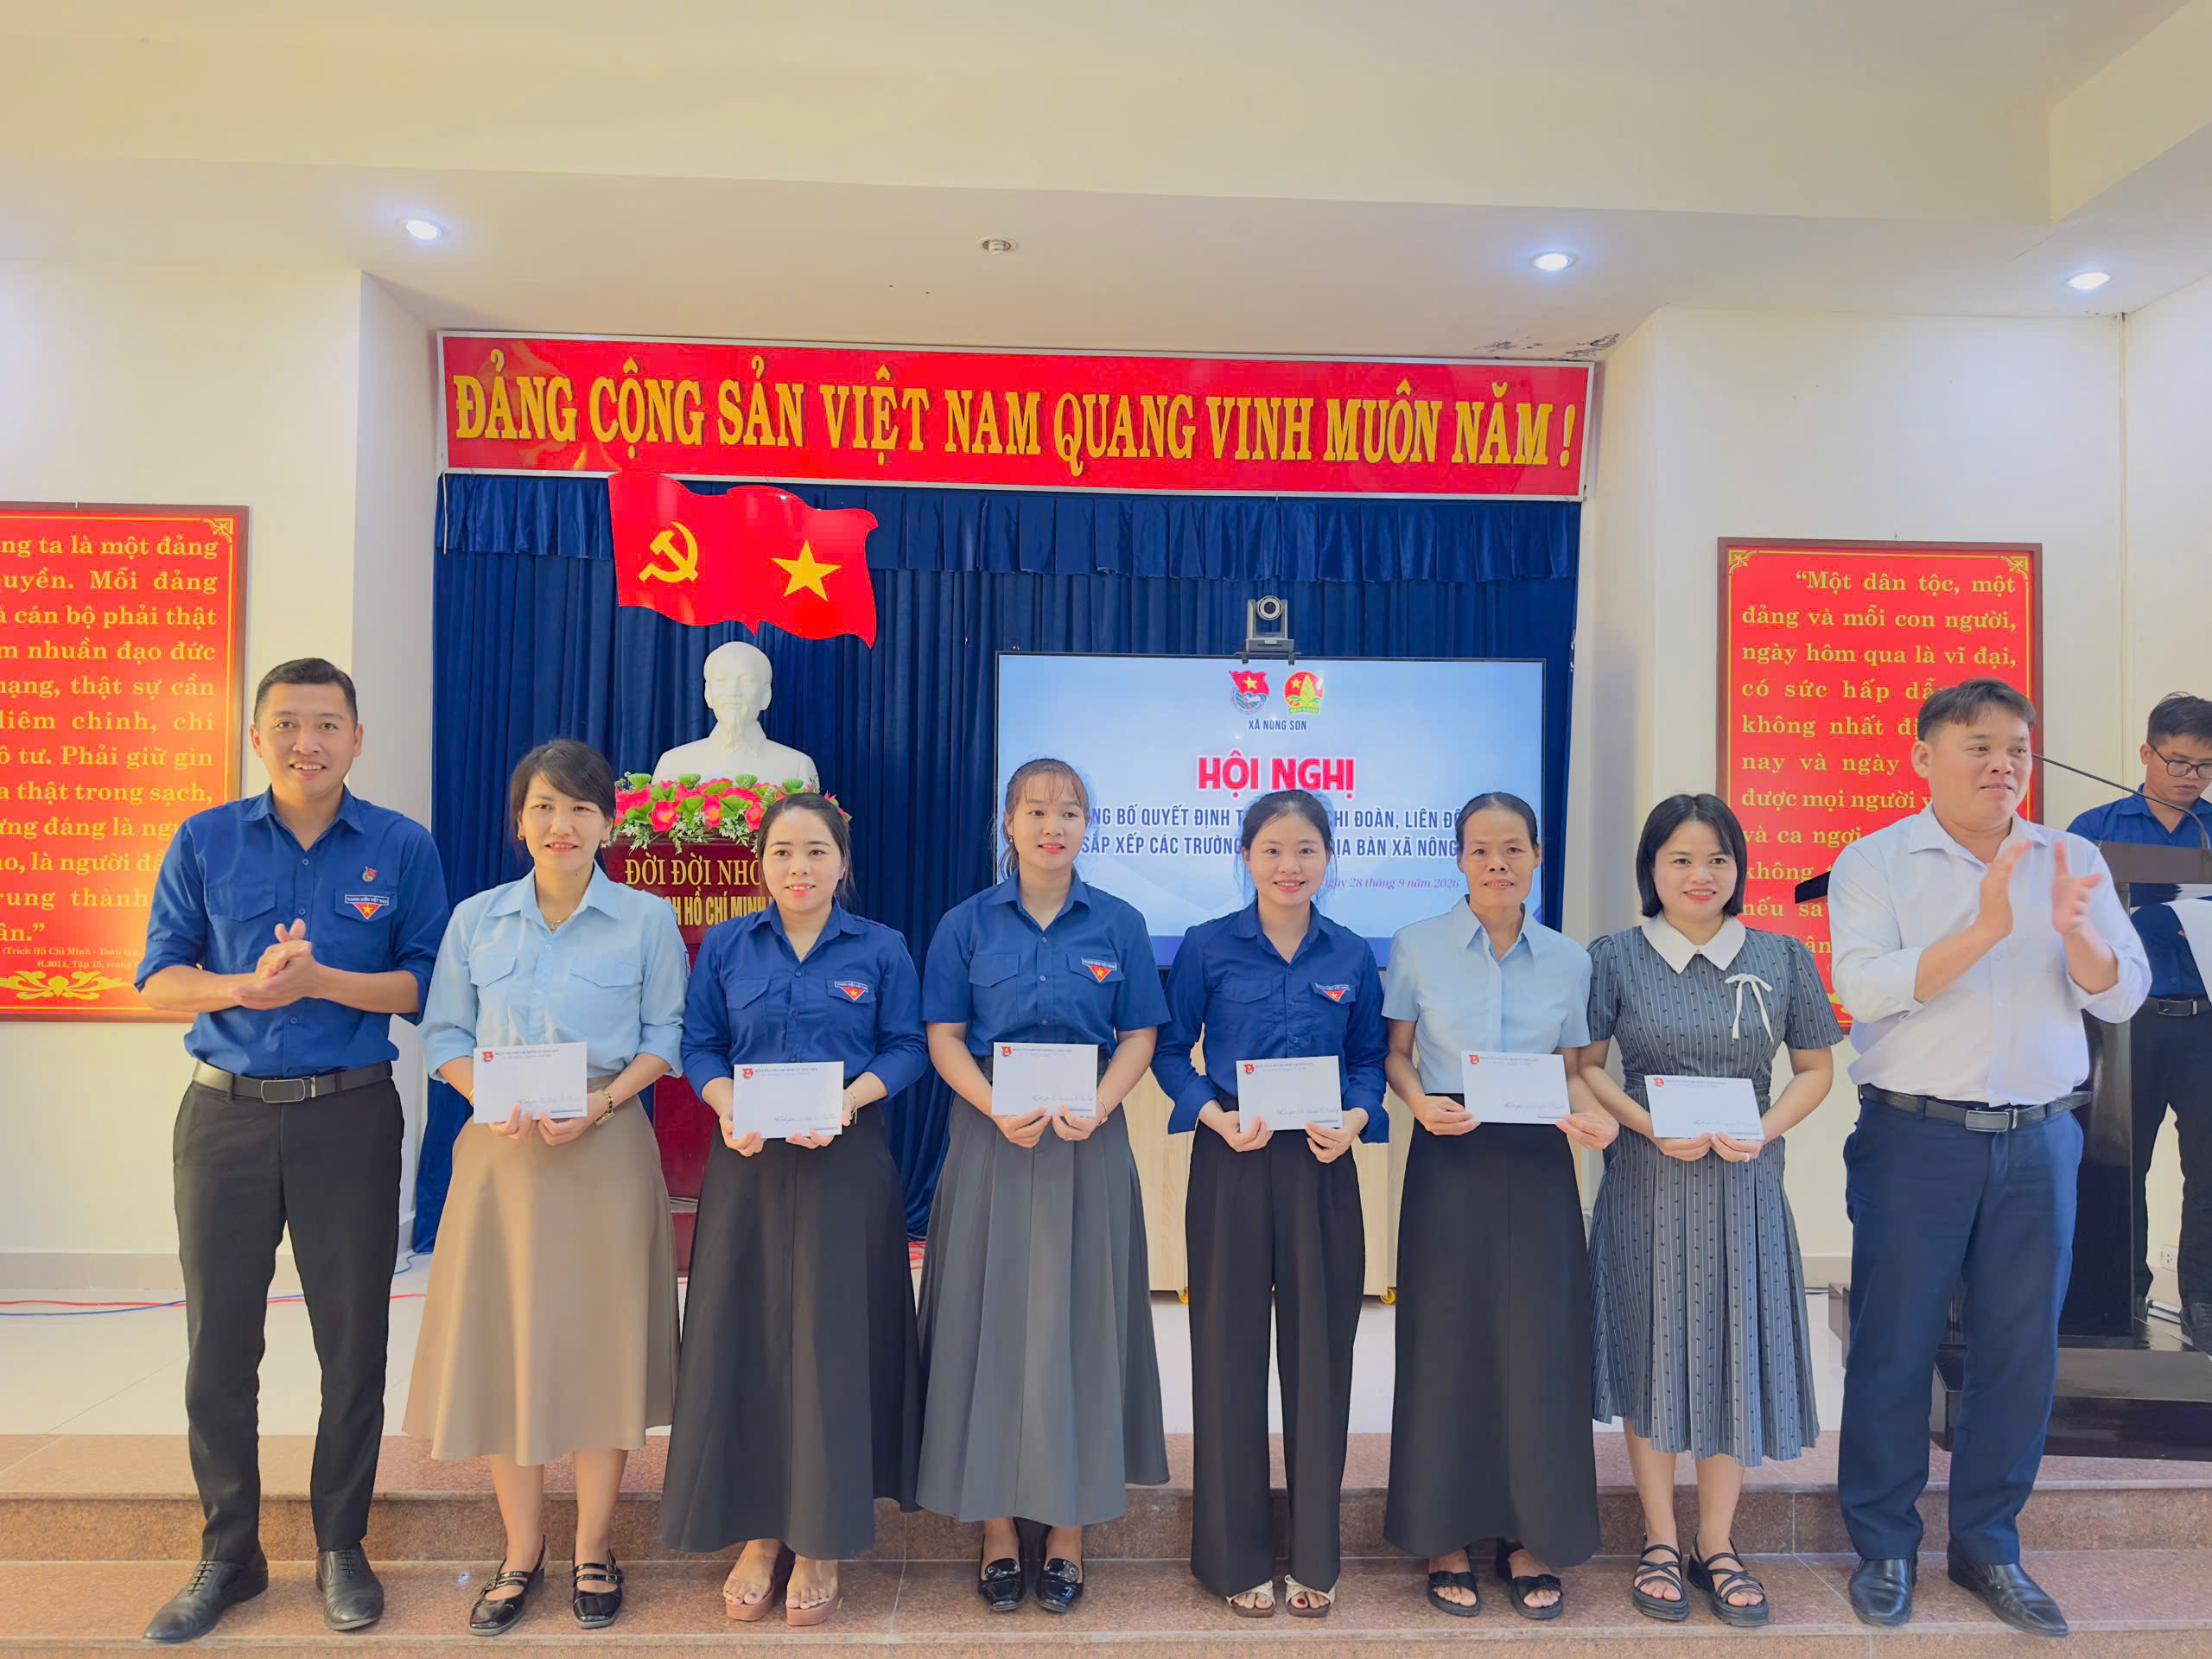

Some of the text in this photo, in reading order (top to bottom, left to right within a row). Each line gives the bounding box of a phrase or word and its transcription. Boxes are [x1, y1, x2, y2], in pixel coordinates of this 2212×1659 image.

[454, 349, 578, 441] ĐẢNG
[588, 356, 705, 460] CỘNG
[717, 355, 804, 447] SẢN
[819, 364, 931, 467] VIỆT
[944, 390, 1041, 455] NAM
[1053, 392, 1196, 477] QUANG
[1205, 397, 1314, 461] VINH
[1323, 378, 1443, 464] MUÔN
[1451, 382, 1554, 467] NĂM
[40, 537, 63, 554] ta
[72, 536, 93, 554] là
[101, 536, 149, 560] một
[156, 535, 219, 560] đảng
[0, 567, 218, 594] uyền. Mỗi đảng
[1796, 570, 2016, 597] “Một dân tộc, một
[15, 606, 58, 624] cán
[67, 606, 95, 629] bộ
[104, 605, 157, 628] phải
[166, 607, 216, 631] thật
[1742, 605, 2017, 632] đảng và mỗi con người,
[28, 637, 108, 659] nhuần
[117, 641, 162, 664] đạo
[170, 642, 216, 661] đức
[1742, 643, 2017, 670] ngày hôm qua là vĩ đại,
[71, 675, 123, 700] thật
[132, 678, 162, 700] sự
[170, 673, 214, 696] cần
[1742, 678, 1770, 697] có
[1785, 678, 1827, 698] sức
[1843, 678, 1890, 702] hấp
[72, 711, 158, 733] chính,
[173, 711, 214, 730] chí
[1742, 715, 1815, 739] không
[1829, 715, 1884, 736] nhất
[18, 747, 51, 766] tư.
[61, 745, 118, 766] Phải
[126, 748, 167, 770] giữ
[175, 750, 214, 769] gìn
[1742, 753, 1900, 777] nay và ngày
[1198, 750, 1354, 799] HỘI NGHỊ
[17, 781, 68, 805] thật
[75, 785, 143, 805] trong
[149, 785, 213, 806] sạch,
[1742, 788, 1797, 811] được
[1802, 789, 1846, 813] mọi
[1852, 790, 1916, 811] người
[43, 817, 106, 839] đáng
[112, 817, 138, 836] là
[1117, 804, 1138, 825] BỐ
[1141, 804, 1189, 826] QUYẾT
[1194, 809, 1230, 829] ĐỊNH
[1355, 807, 1399, 830] ĐOÀN,
[1405, 808, 1438, 829] LIÊN
[1082, 831, 1110, 854] SẮP
[1116, 832, 1144, 854] XẾP
[1150, 835, 1178, 855] CÁC
[1357, 836, 1387, 856] BÀN
[1392, 836, 1413, 856] XÃ
[1418, 836, 1458, 857] NÔNG
[1744, 825, 1768, 843] và
[1777, 830, 1802, 843] ca
[31, 852, 54, 871] là
[60, 852, 130, 874] người
[625, 852, 664, 885] ĐỜI
[671, 853, 711, 886] ĐỜI
[1351, 878, 1363, 887] 28
[1398, 878, 1406, 887] 9
[71, 888, 149, 906] thành
[684, 887, 702, 925] HỒ
[705, 891, 728, 925] CHÍ
[1742, 896, 1823, 917] nếu sa
